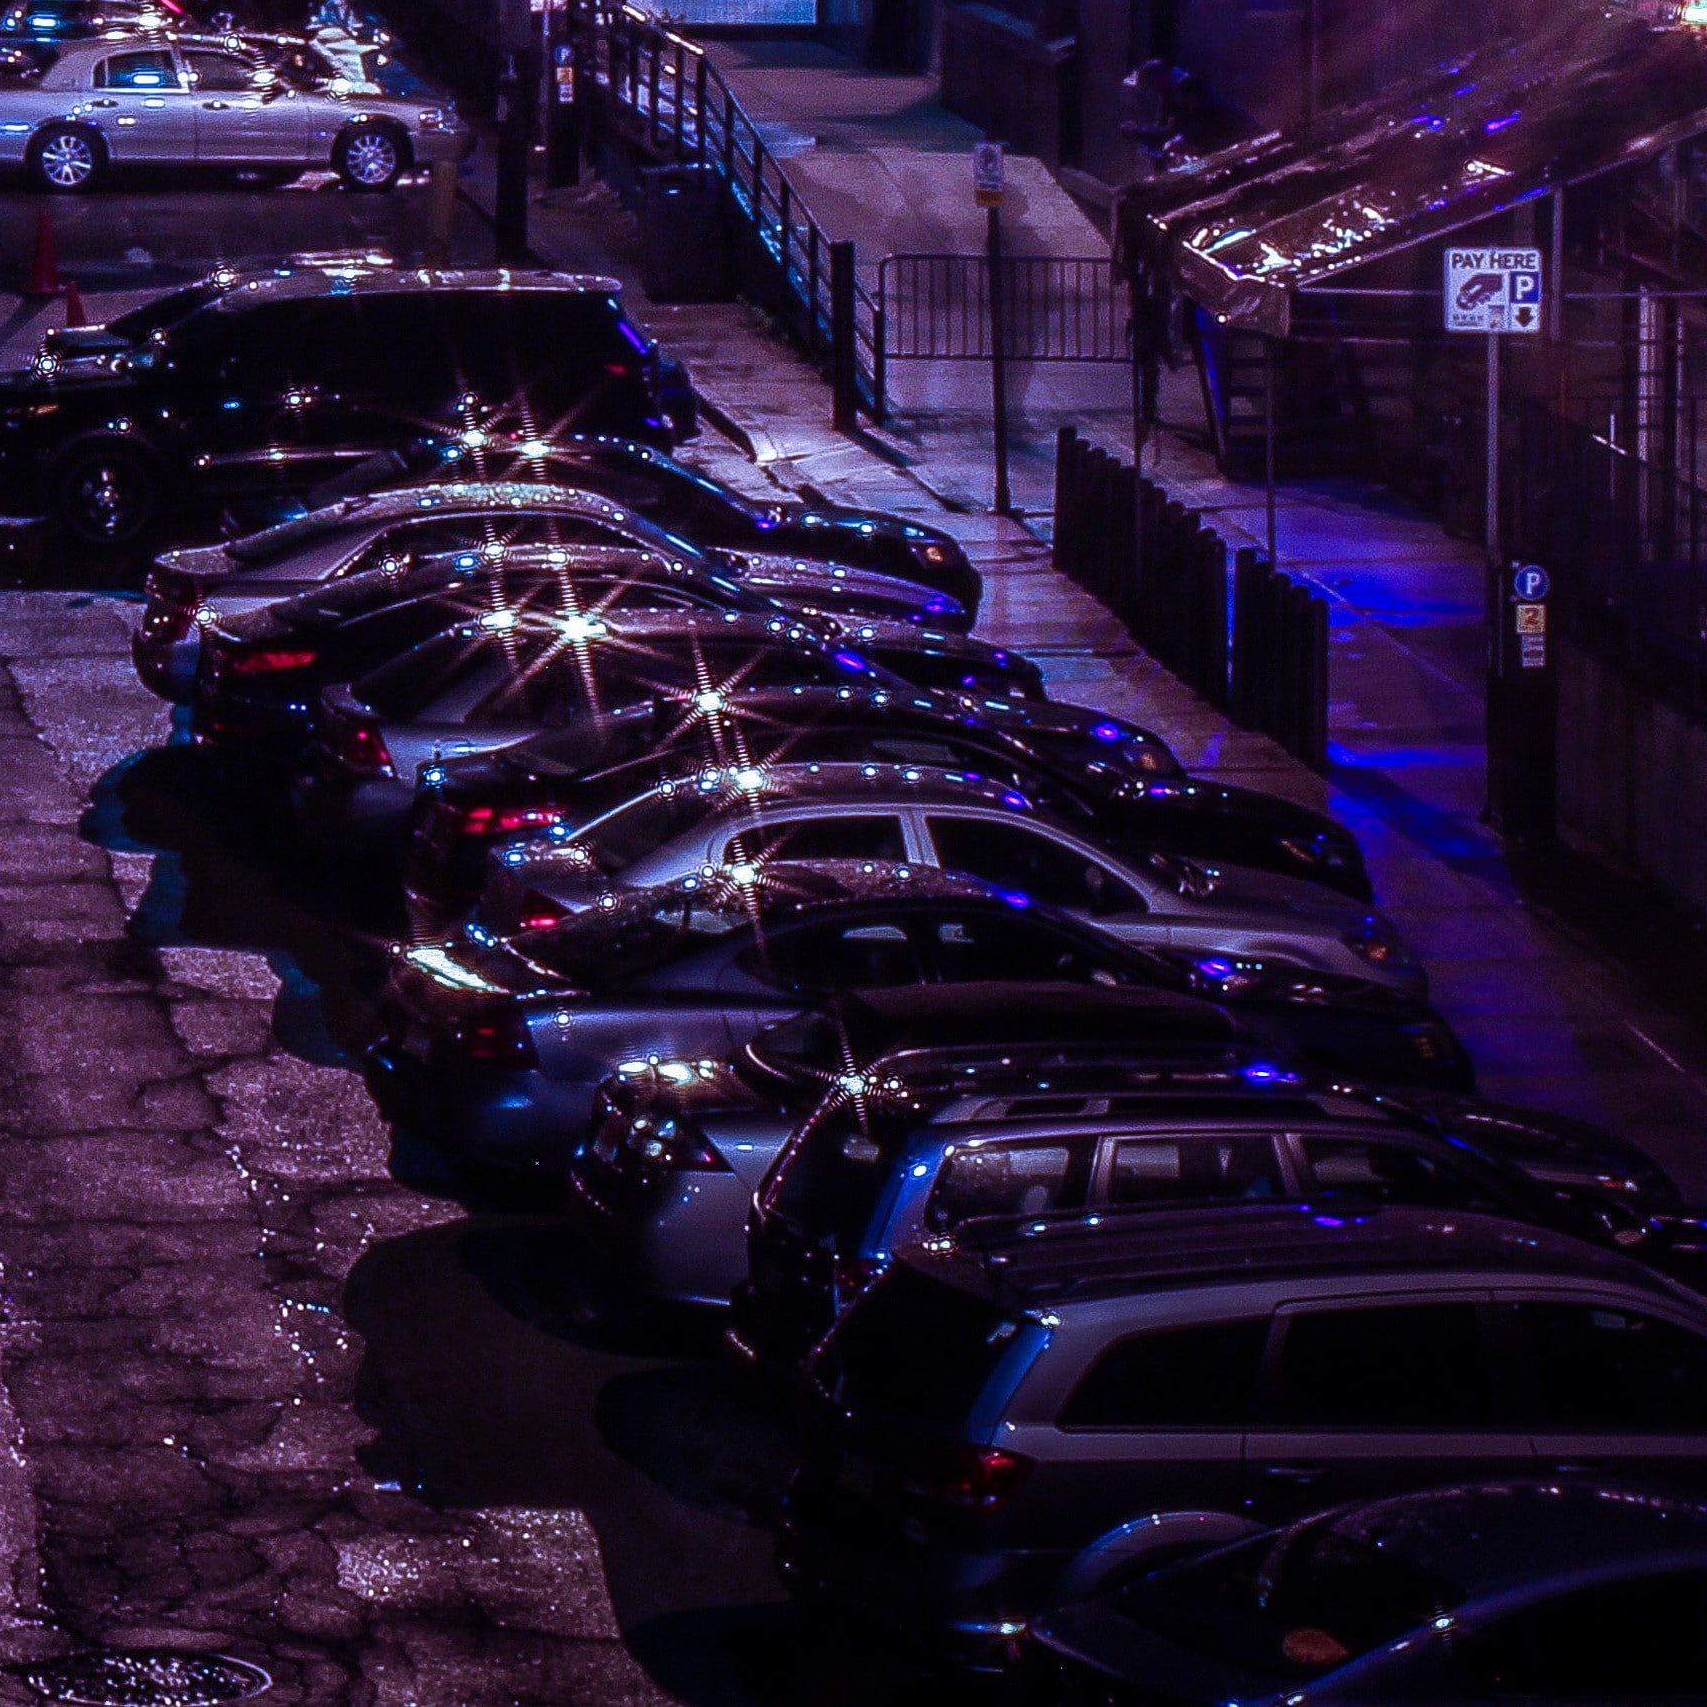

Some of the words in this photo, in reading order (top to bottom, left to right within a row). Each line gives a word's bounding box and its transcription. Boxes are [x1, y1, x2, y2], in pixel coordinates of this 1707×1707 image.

[1451, 253, 1484, 270] PAY
[1489, 252, 1537, 270] HERE
[1515, 275, 1534, 301] P
[1525, 572, 1541, 595] P
[1524, 607, 1540, 625] 2
